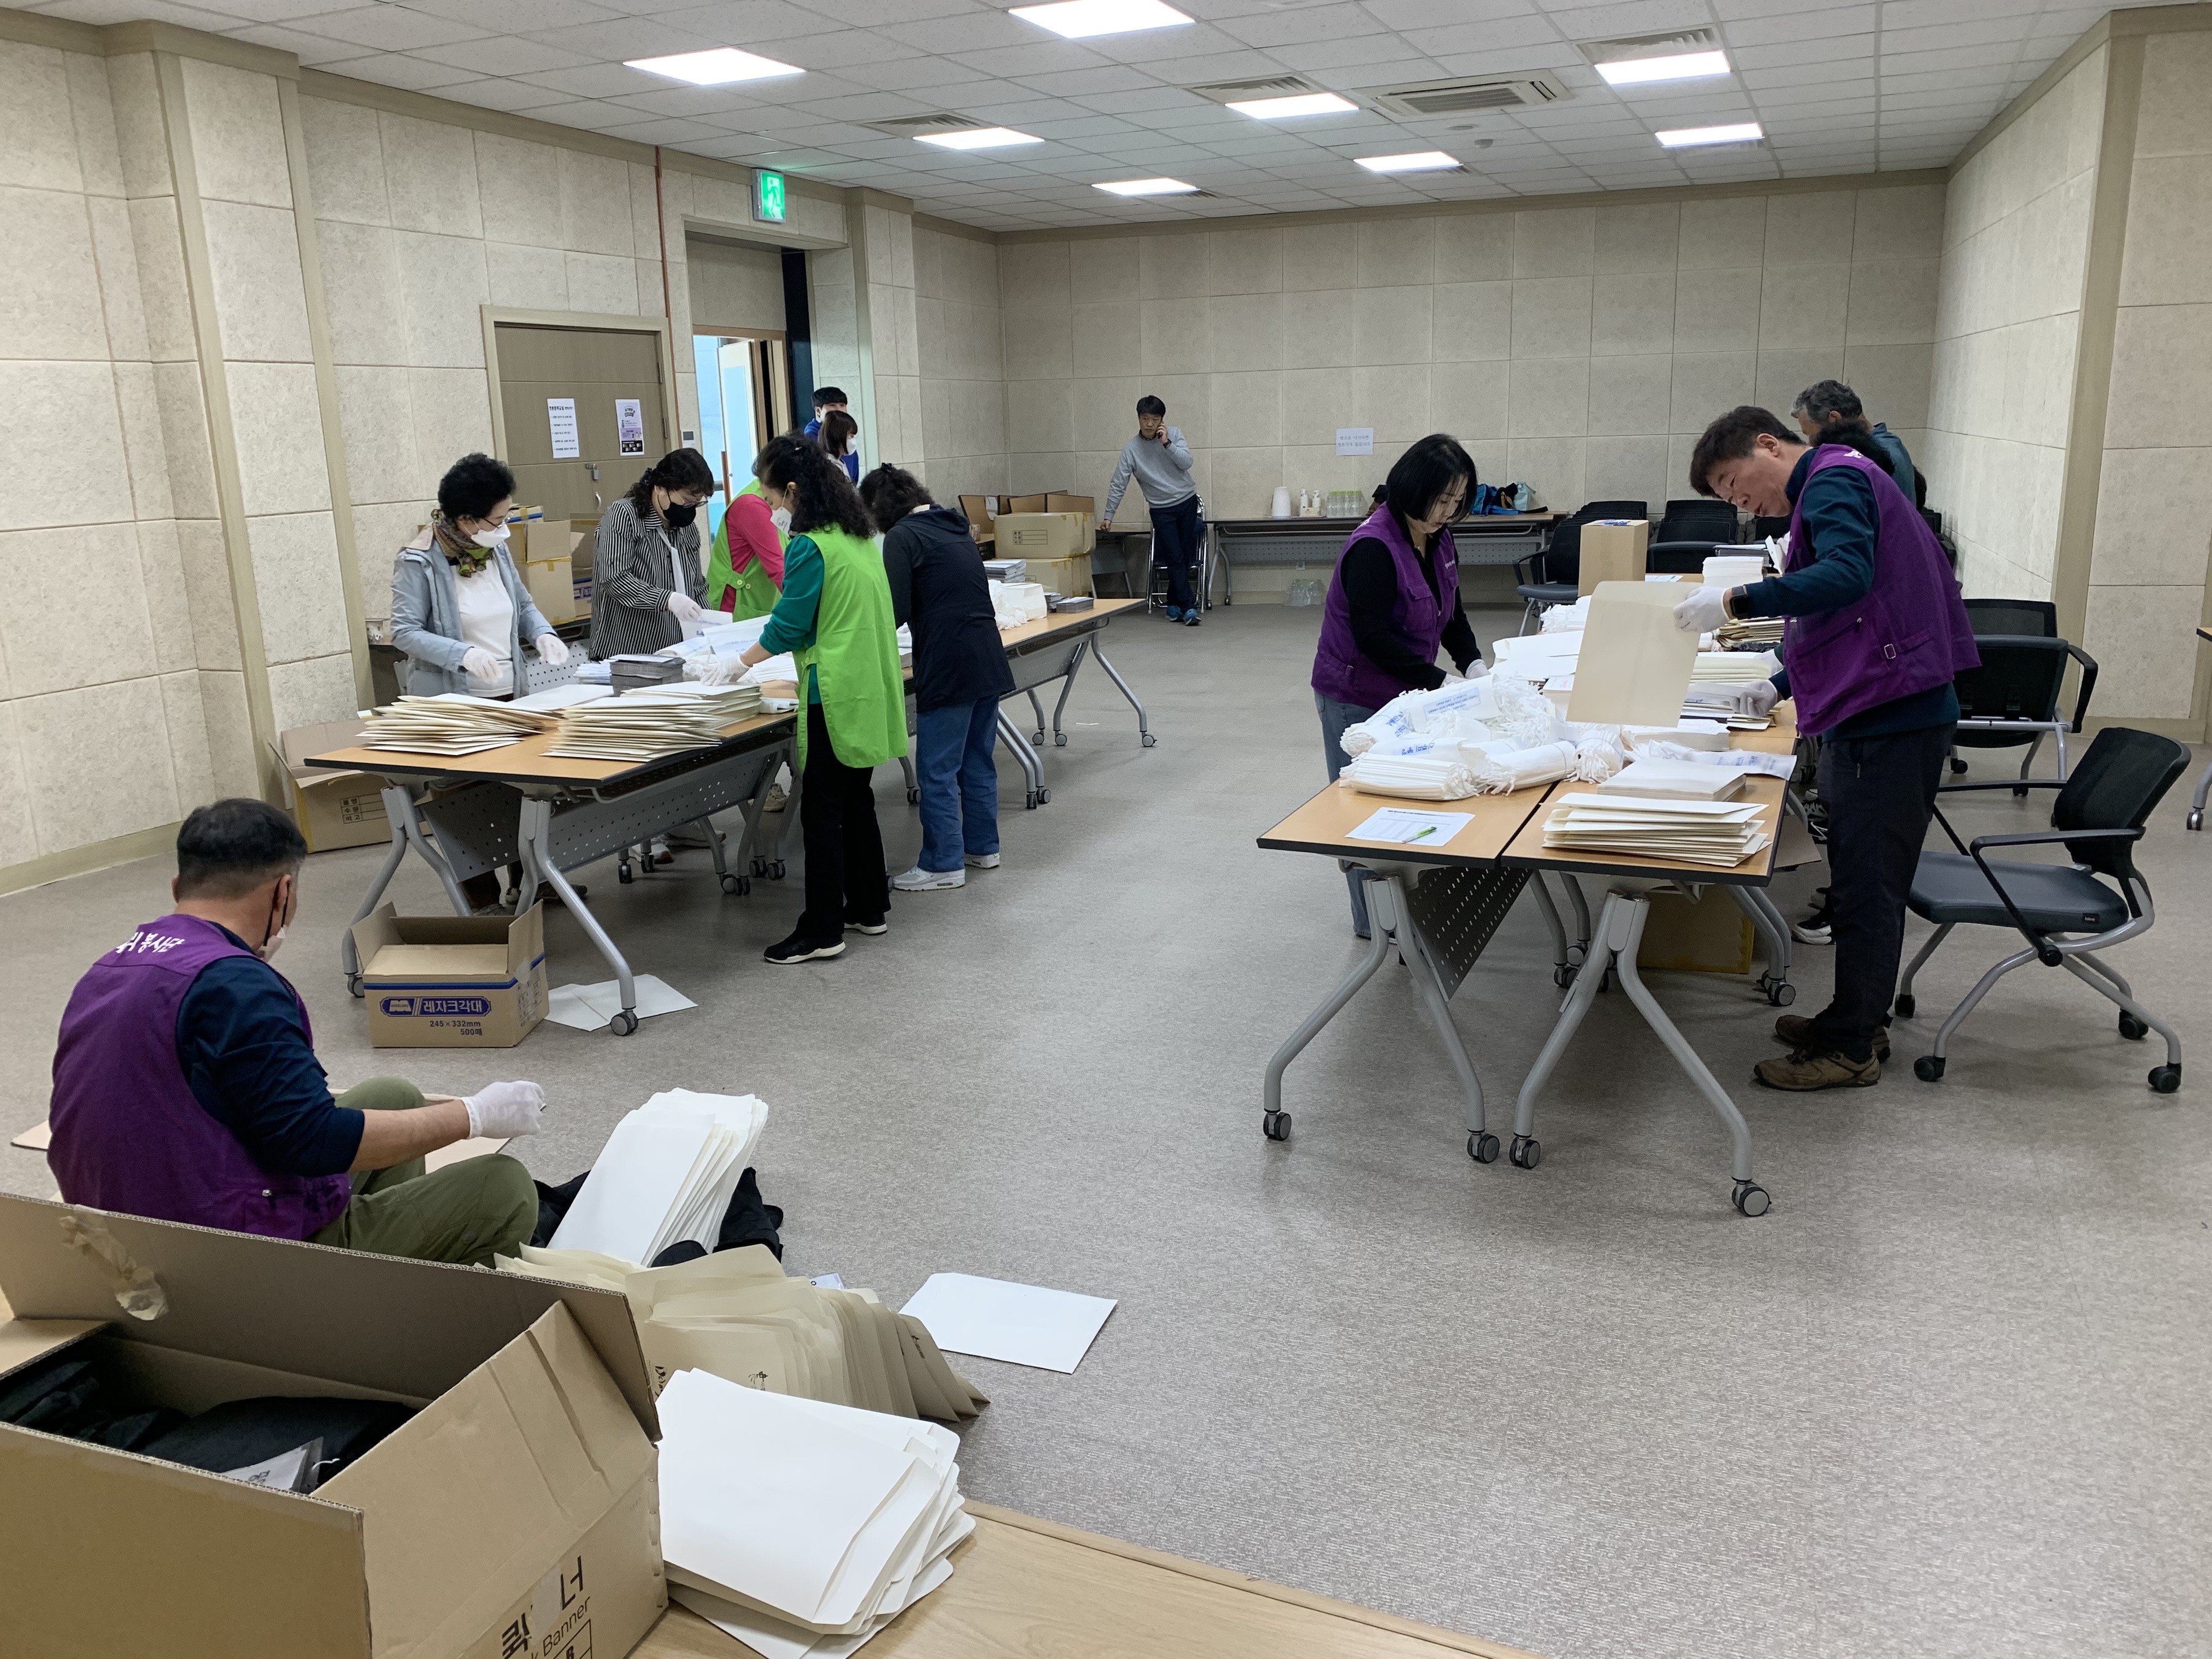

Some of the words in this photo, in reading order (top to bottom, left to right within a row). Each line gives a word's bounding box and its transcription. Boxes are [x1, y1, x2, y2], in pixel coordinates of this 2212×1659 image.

[138, 933, 185, 953] 봉사단
[423, 1000, 482, 1013] 레자크각대
[543, 1596, 590, 1657] Banner
